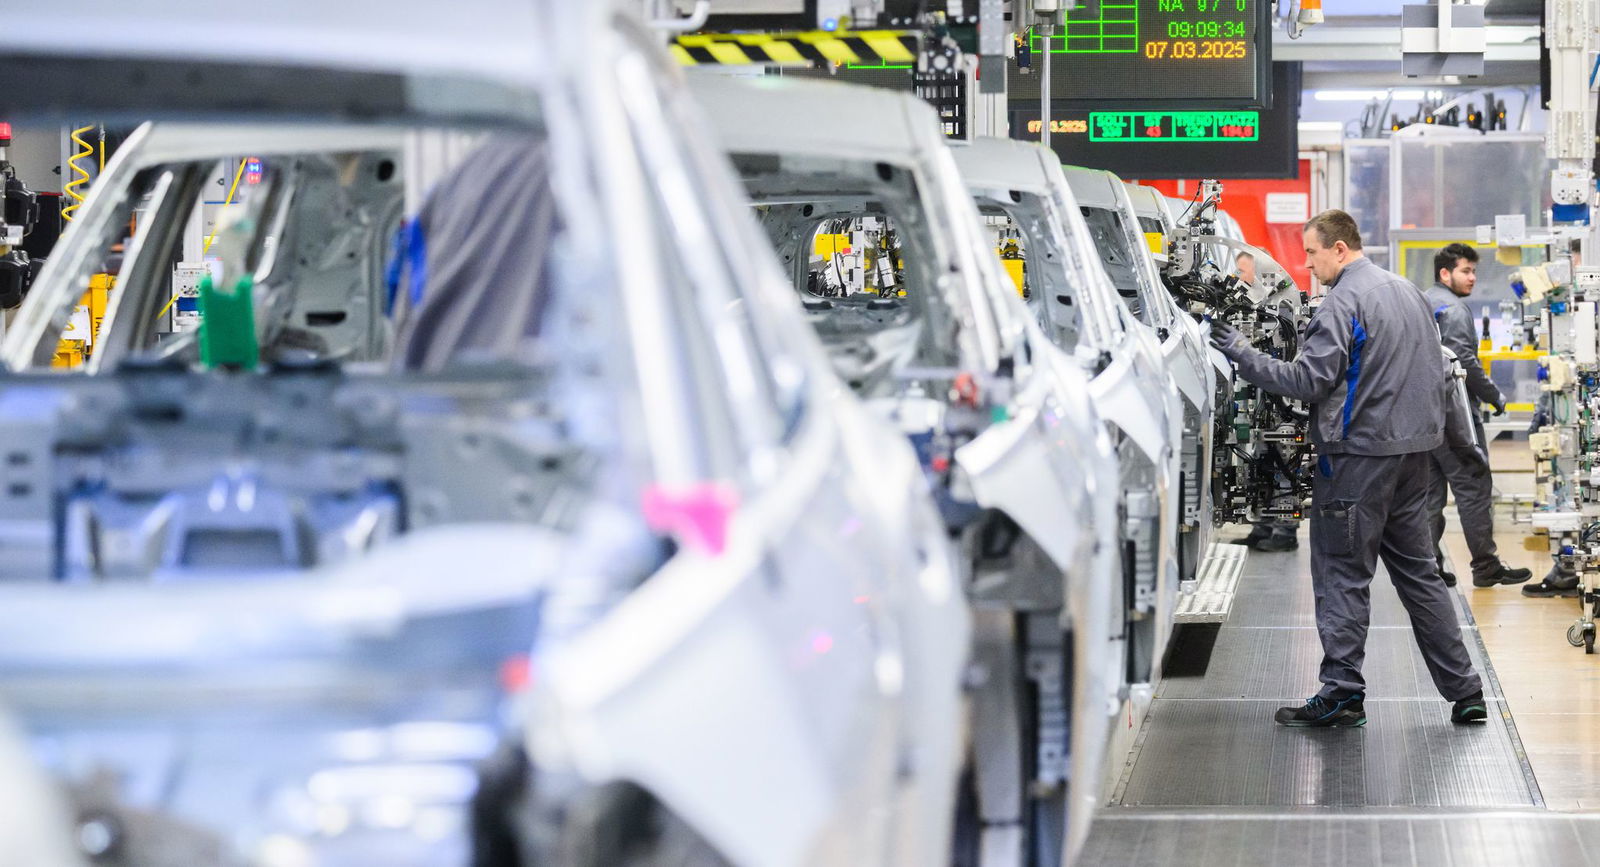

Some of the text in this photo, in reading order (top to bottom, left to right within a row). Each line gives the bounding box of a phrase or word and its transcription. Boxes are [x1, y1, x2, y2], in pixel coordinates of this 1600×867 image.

[1158, 0, 1184, 12] NA
[1168, 21, 1246, 38] 09:09:34
[1145, 41, 1247, 59] 07.03.2025
